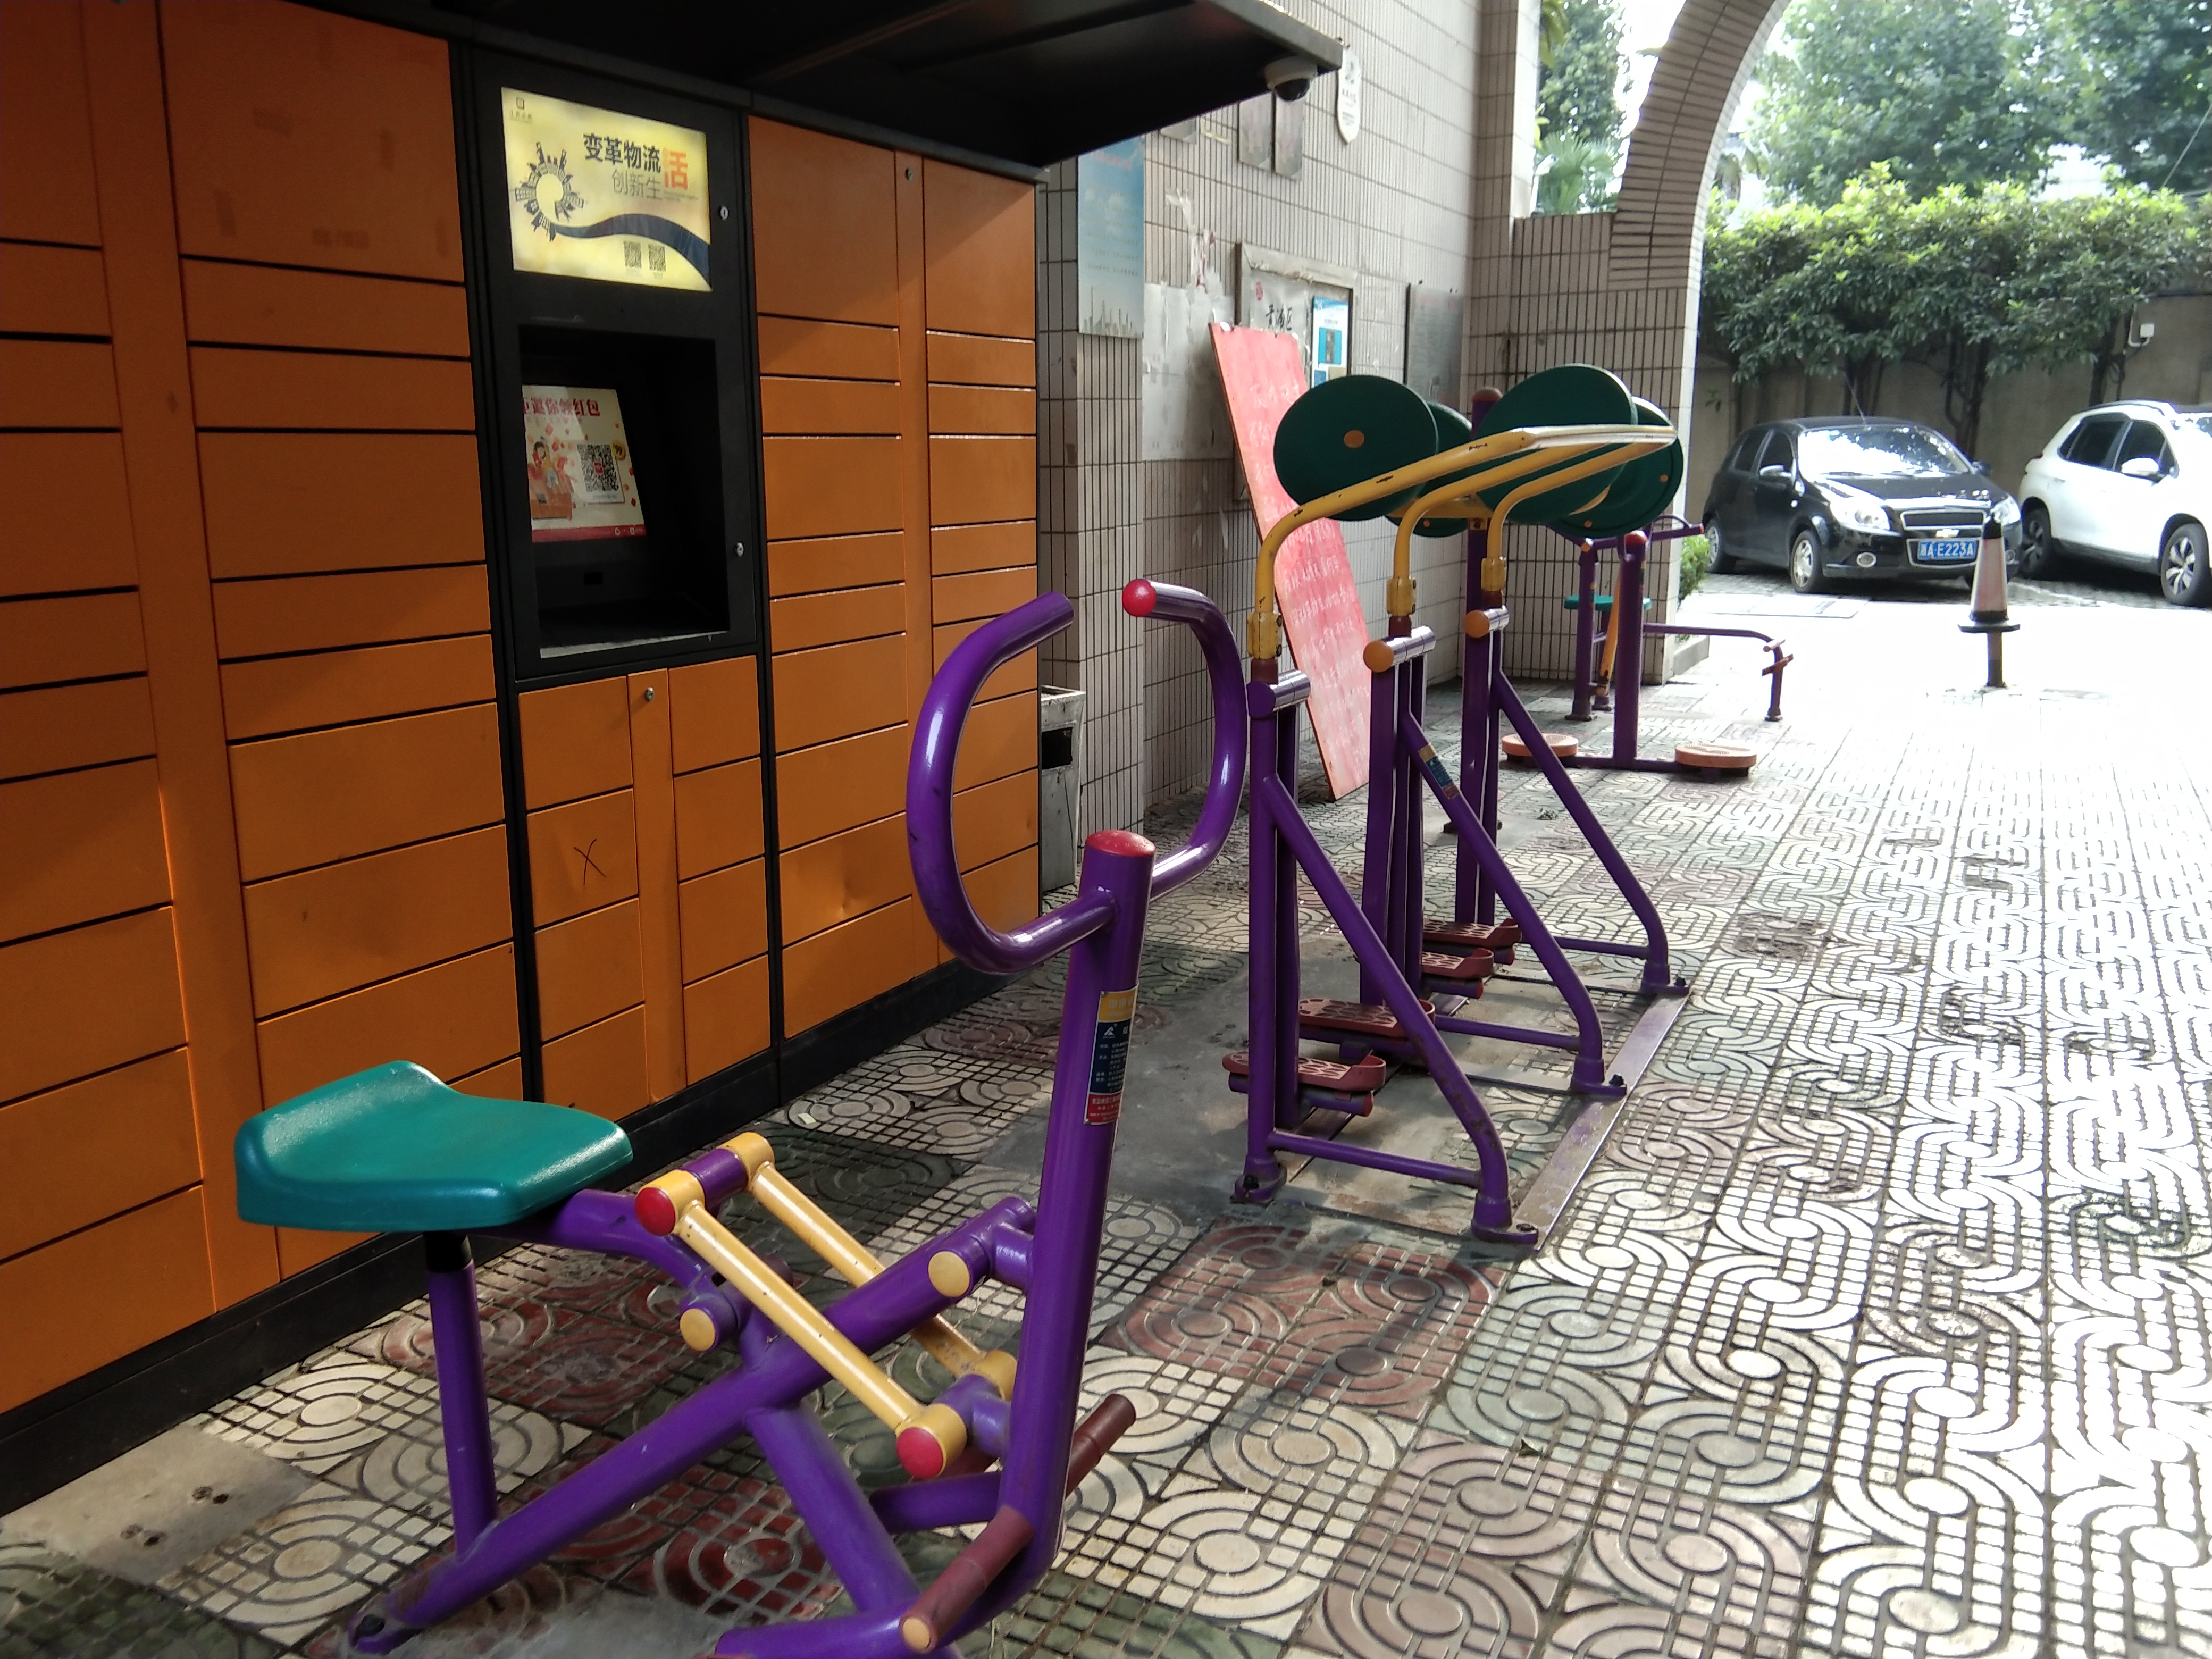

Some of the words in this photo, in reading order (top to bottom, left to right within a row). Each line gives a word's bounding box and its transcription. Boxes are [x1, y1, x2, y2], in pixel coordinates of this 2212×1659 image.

[583, 133, 661, 173] 变革物流
[611, 169, 663, 200] 创新生
